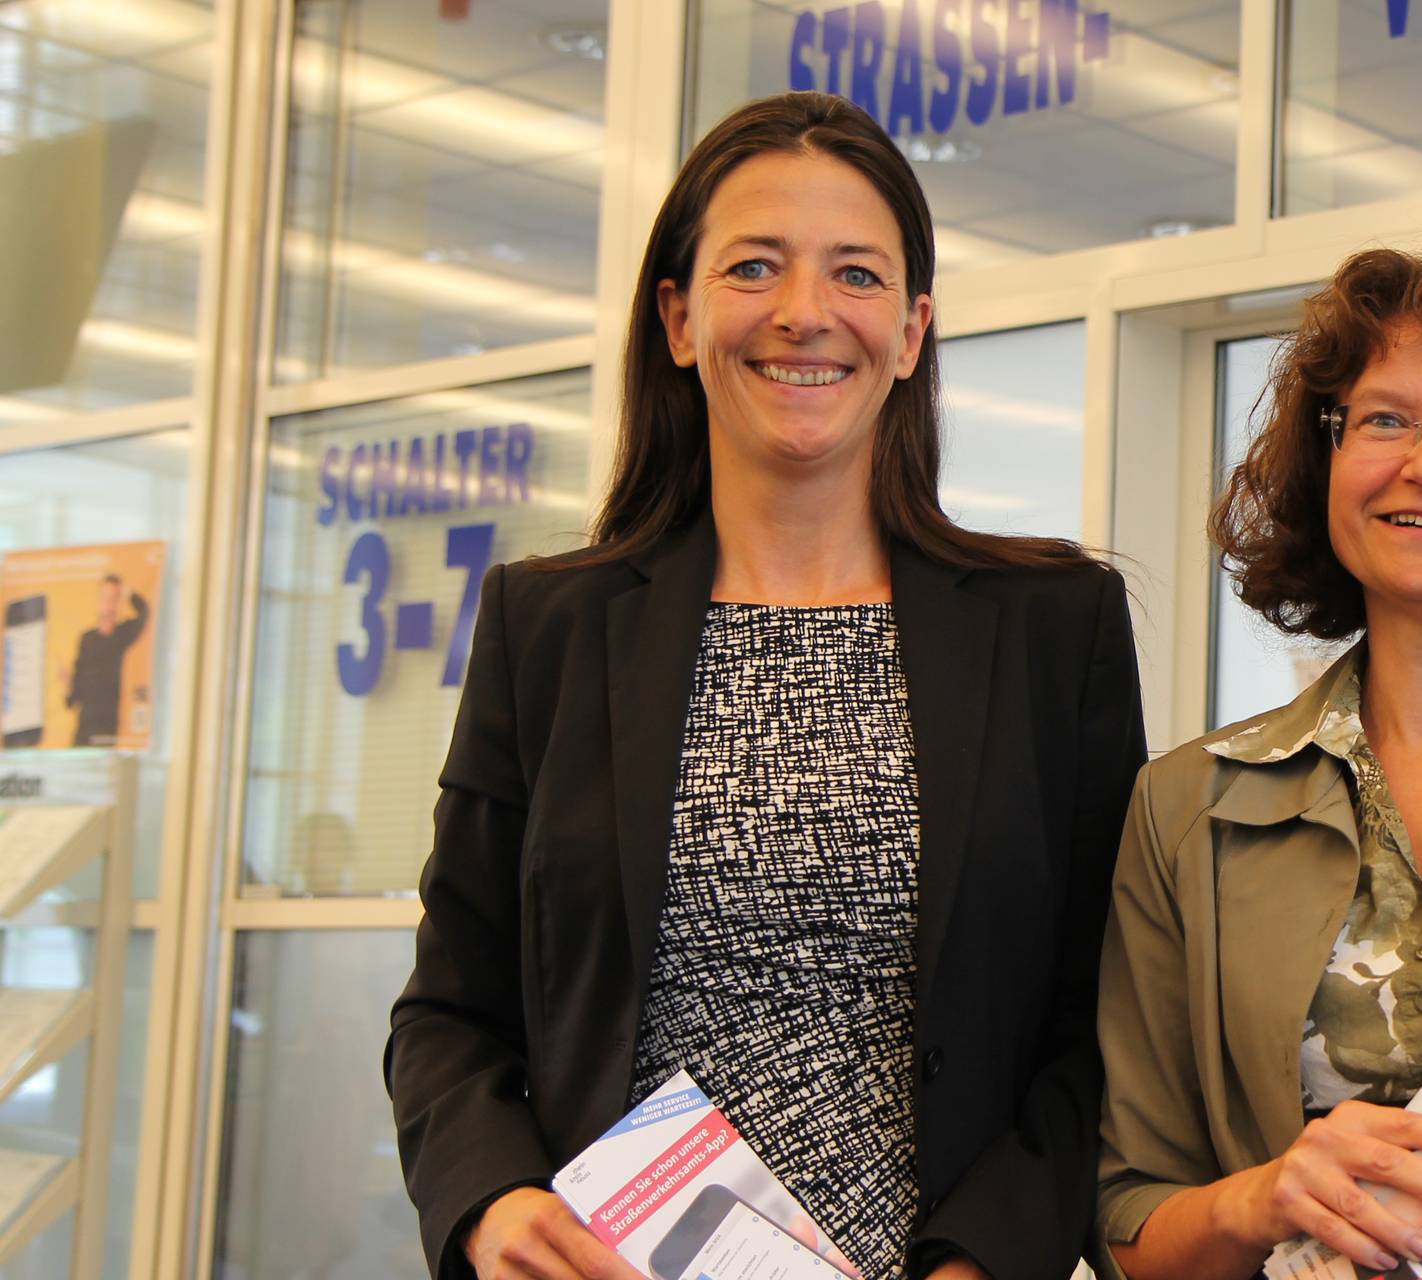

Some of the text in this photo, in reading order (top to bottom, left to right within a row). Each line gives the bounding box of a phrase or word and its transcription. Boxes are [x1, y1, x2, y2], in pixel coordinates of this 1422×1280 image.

[789, 0, 1110, 138] STRASSEN-
[316, 422, 535, 528] SCHALTER
[630, 1110, 662, 1126] WENIGER
[642, 1093, 689, 1114] MEHR SERVICE
[599, 1127, 710, 1224] Kennen Sie schon unsere
[610, 1128, 730, 1236] Straßenverkehrsamts-App?
